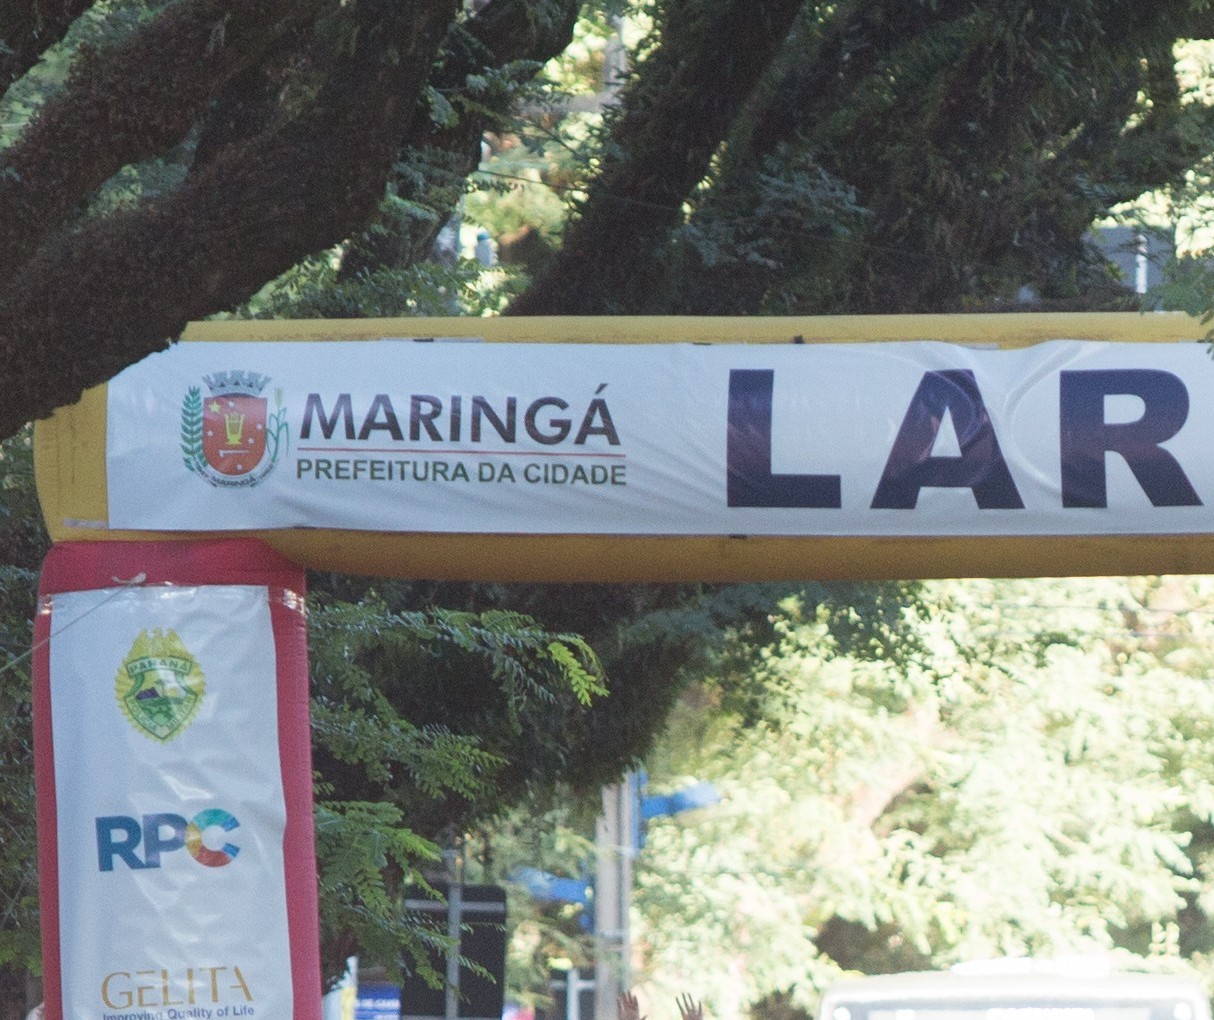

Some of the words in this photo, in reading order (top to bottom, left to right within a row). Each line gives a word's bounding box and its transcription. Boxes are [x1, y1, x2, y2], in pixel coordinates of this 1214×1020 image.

[299, 383, 622, 446] MARINGÁ
[296, 459, 470, 482] PREFEITURA
[478, 462, 516, 483] DA
[523, 463, 627, 486] CIDADE
[95, 808, 241, 872] RPC
[102, 966, 253, 1010] GELITA
[167, 1008, 213, 1020] Quality
[216, 1006, 229, 1017] of
[232, 1005, 254, 1016] Life
